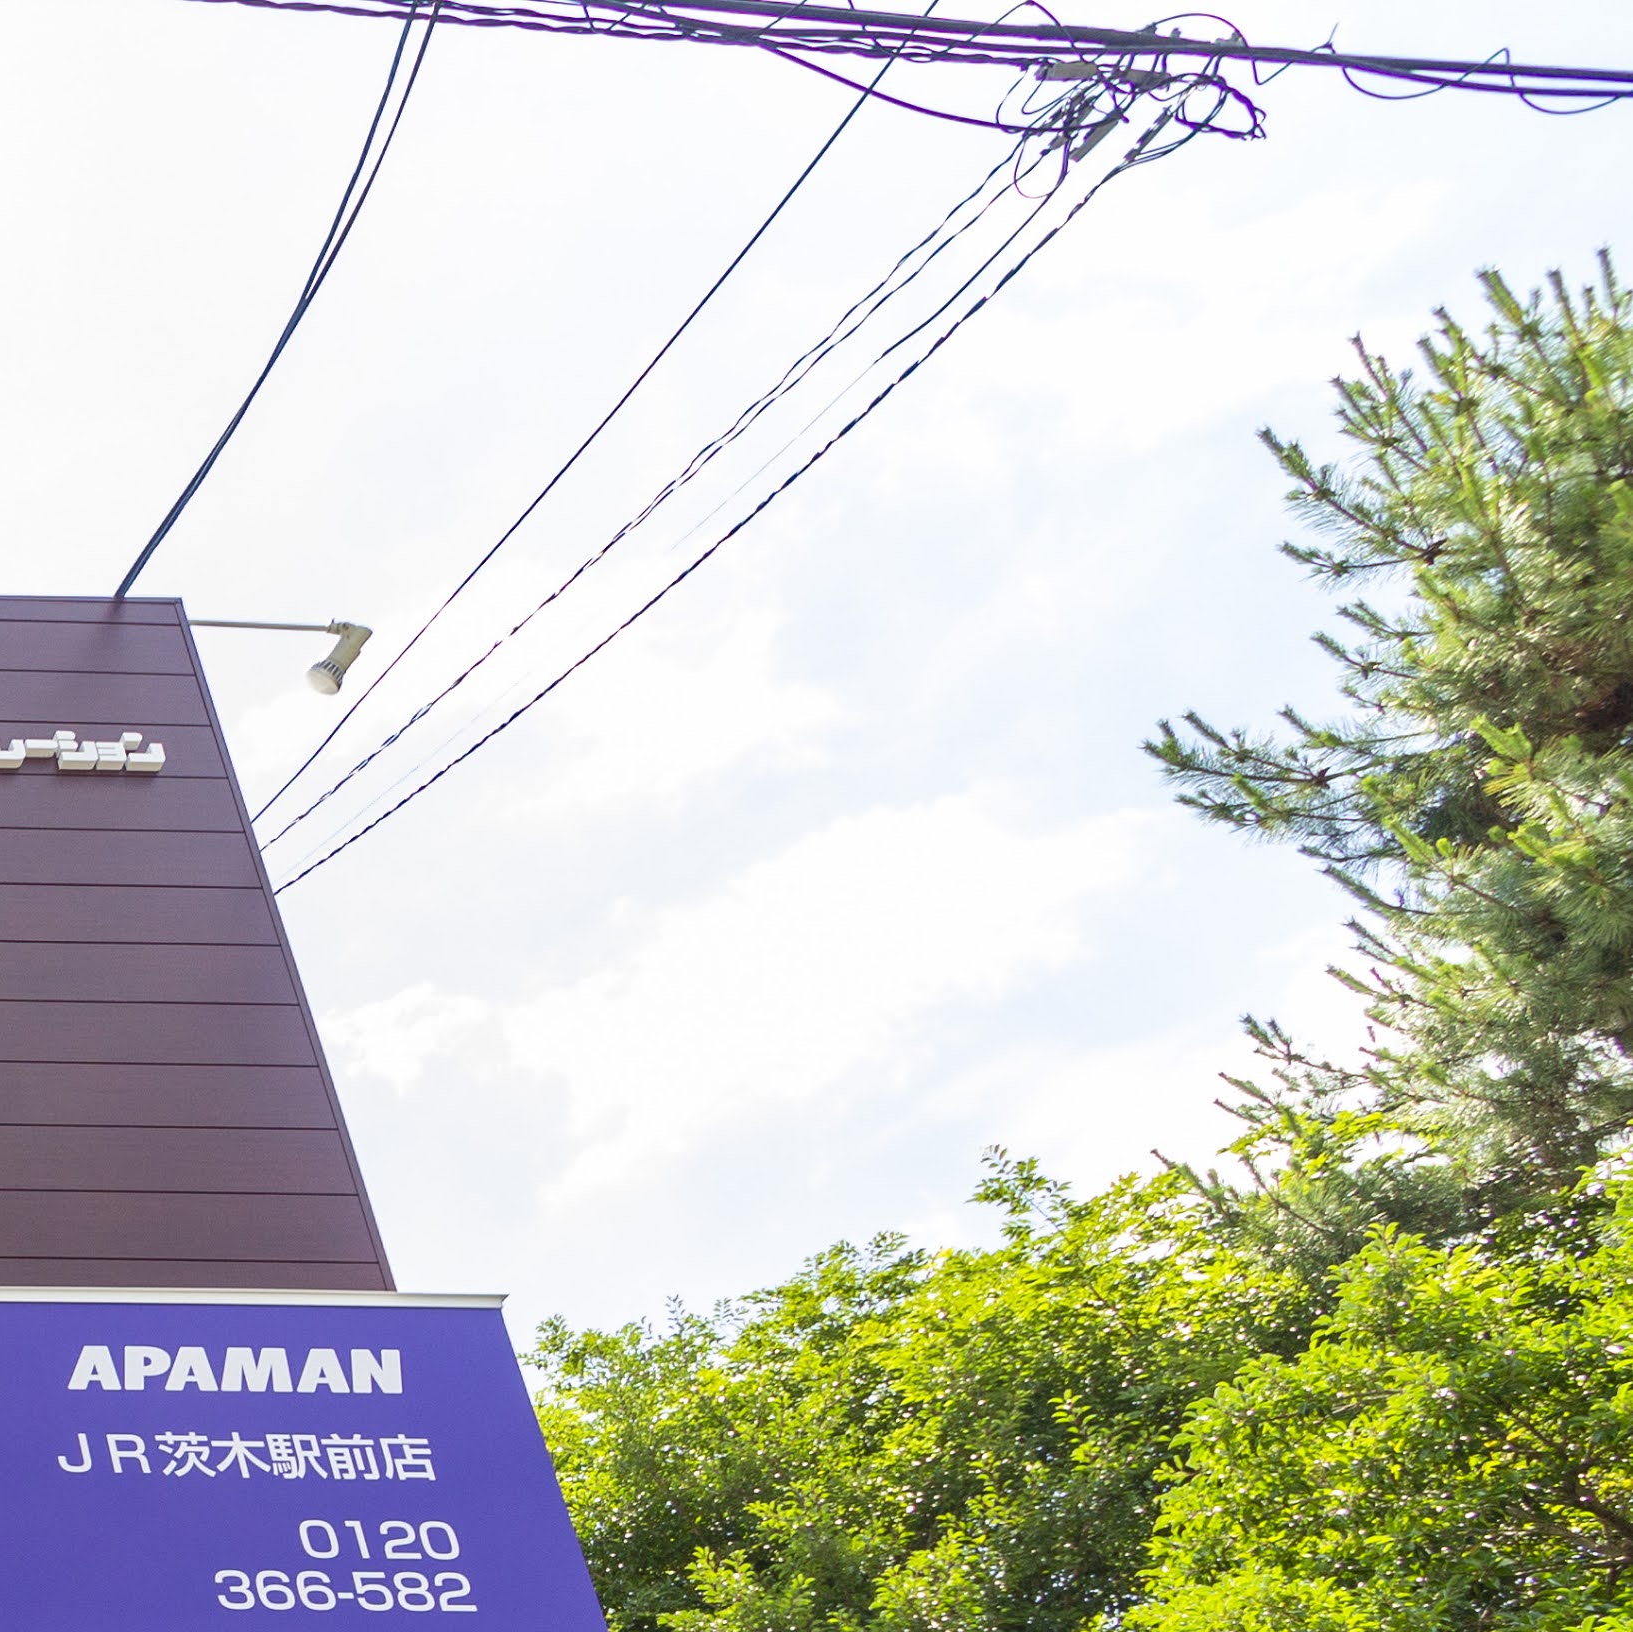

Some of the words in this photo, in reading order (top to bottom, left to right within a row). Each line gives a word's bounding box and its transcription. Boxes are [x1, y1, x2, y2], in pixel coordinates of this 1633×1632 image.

[67, 1345, 403, 1394] APAMAN
[298, 1519, 460, 1561] 0120
[214, 1569, 478, 1612] 366-582
